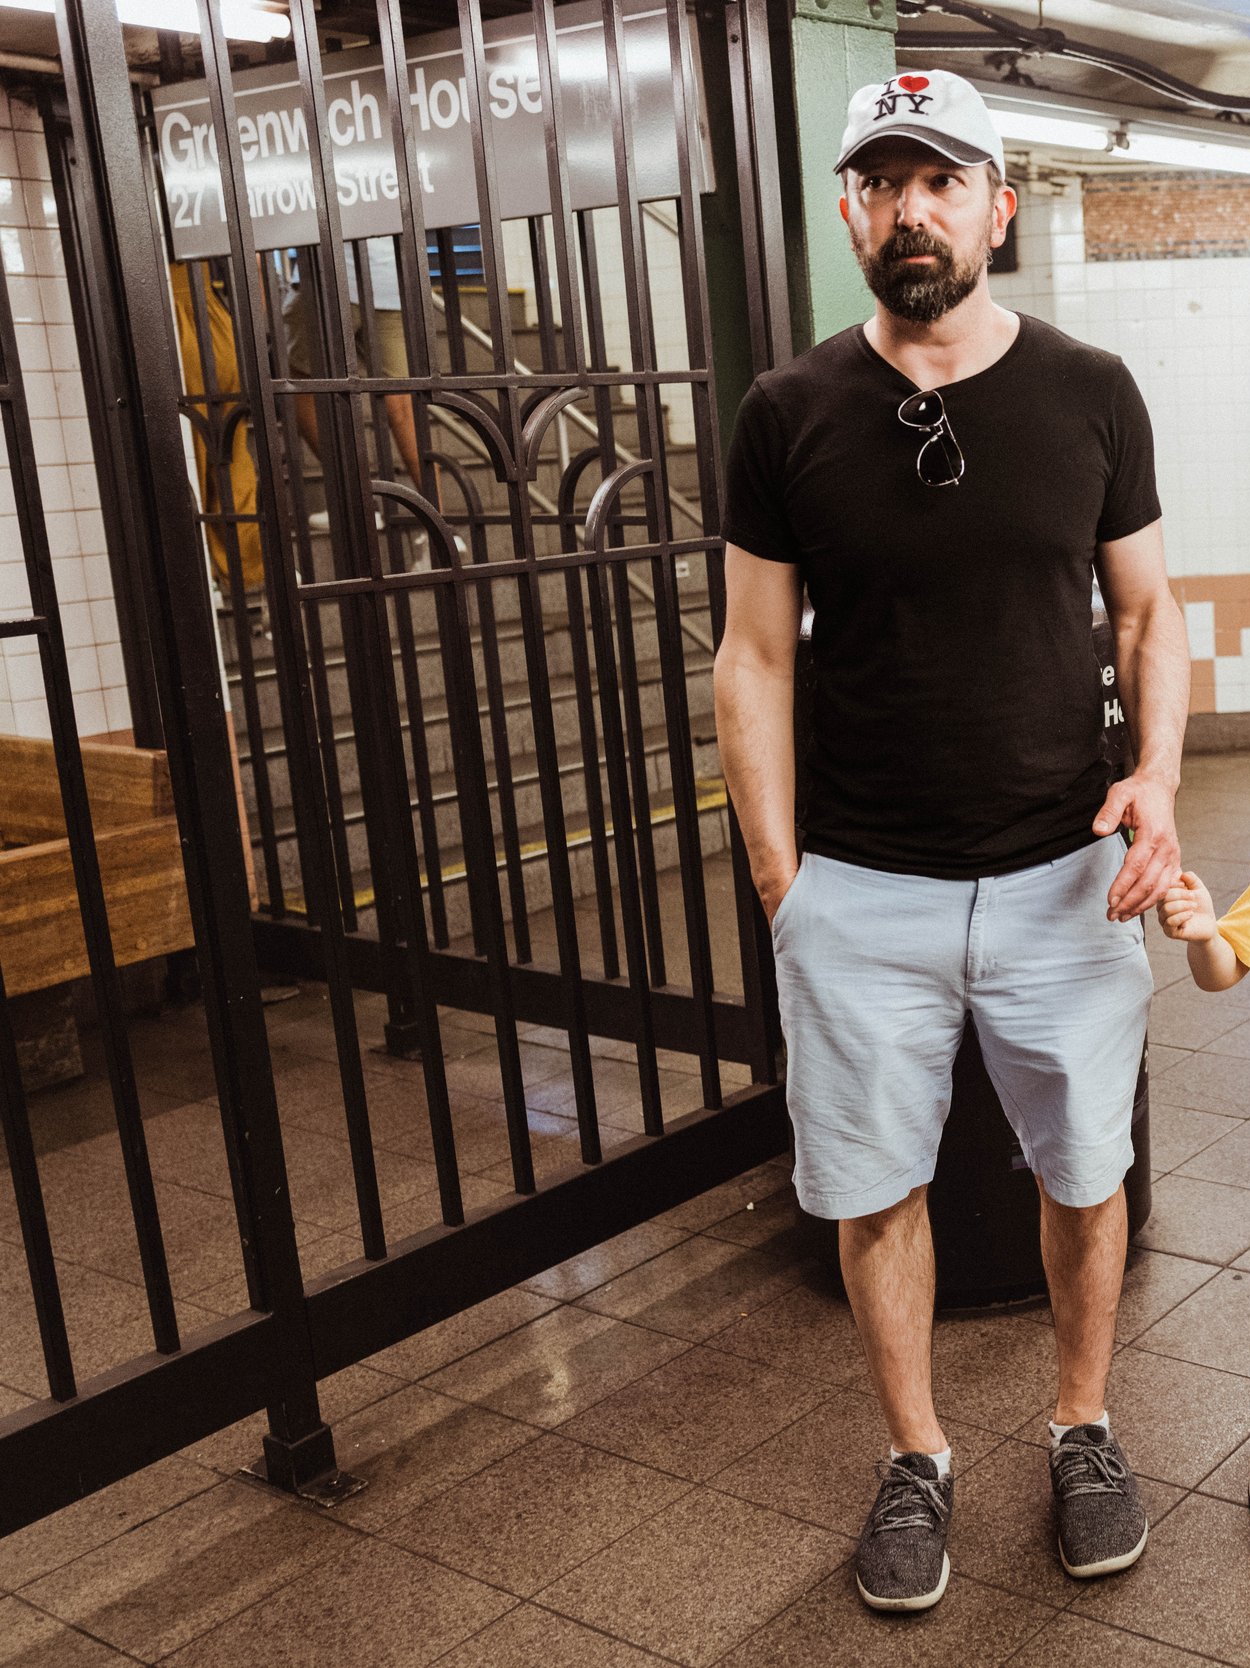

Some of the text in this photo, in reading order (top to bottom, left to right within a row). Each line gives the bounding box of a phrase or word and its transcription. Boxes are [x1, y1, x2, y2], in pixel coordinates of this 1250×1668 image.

[872, 92, 934, 121] NY
[881, 78, 897, 97] I
[161, 65, 543, 169] Grenwch Hose
[169, 183, 206, 229] 27
[335, 151, 436, 207] Stret
